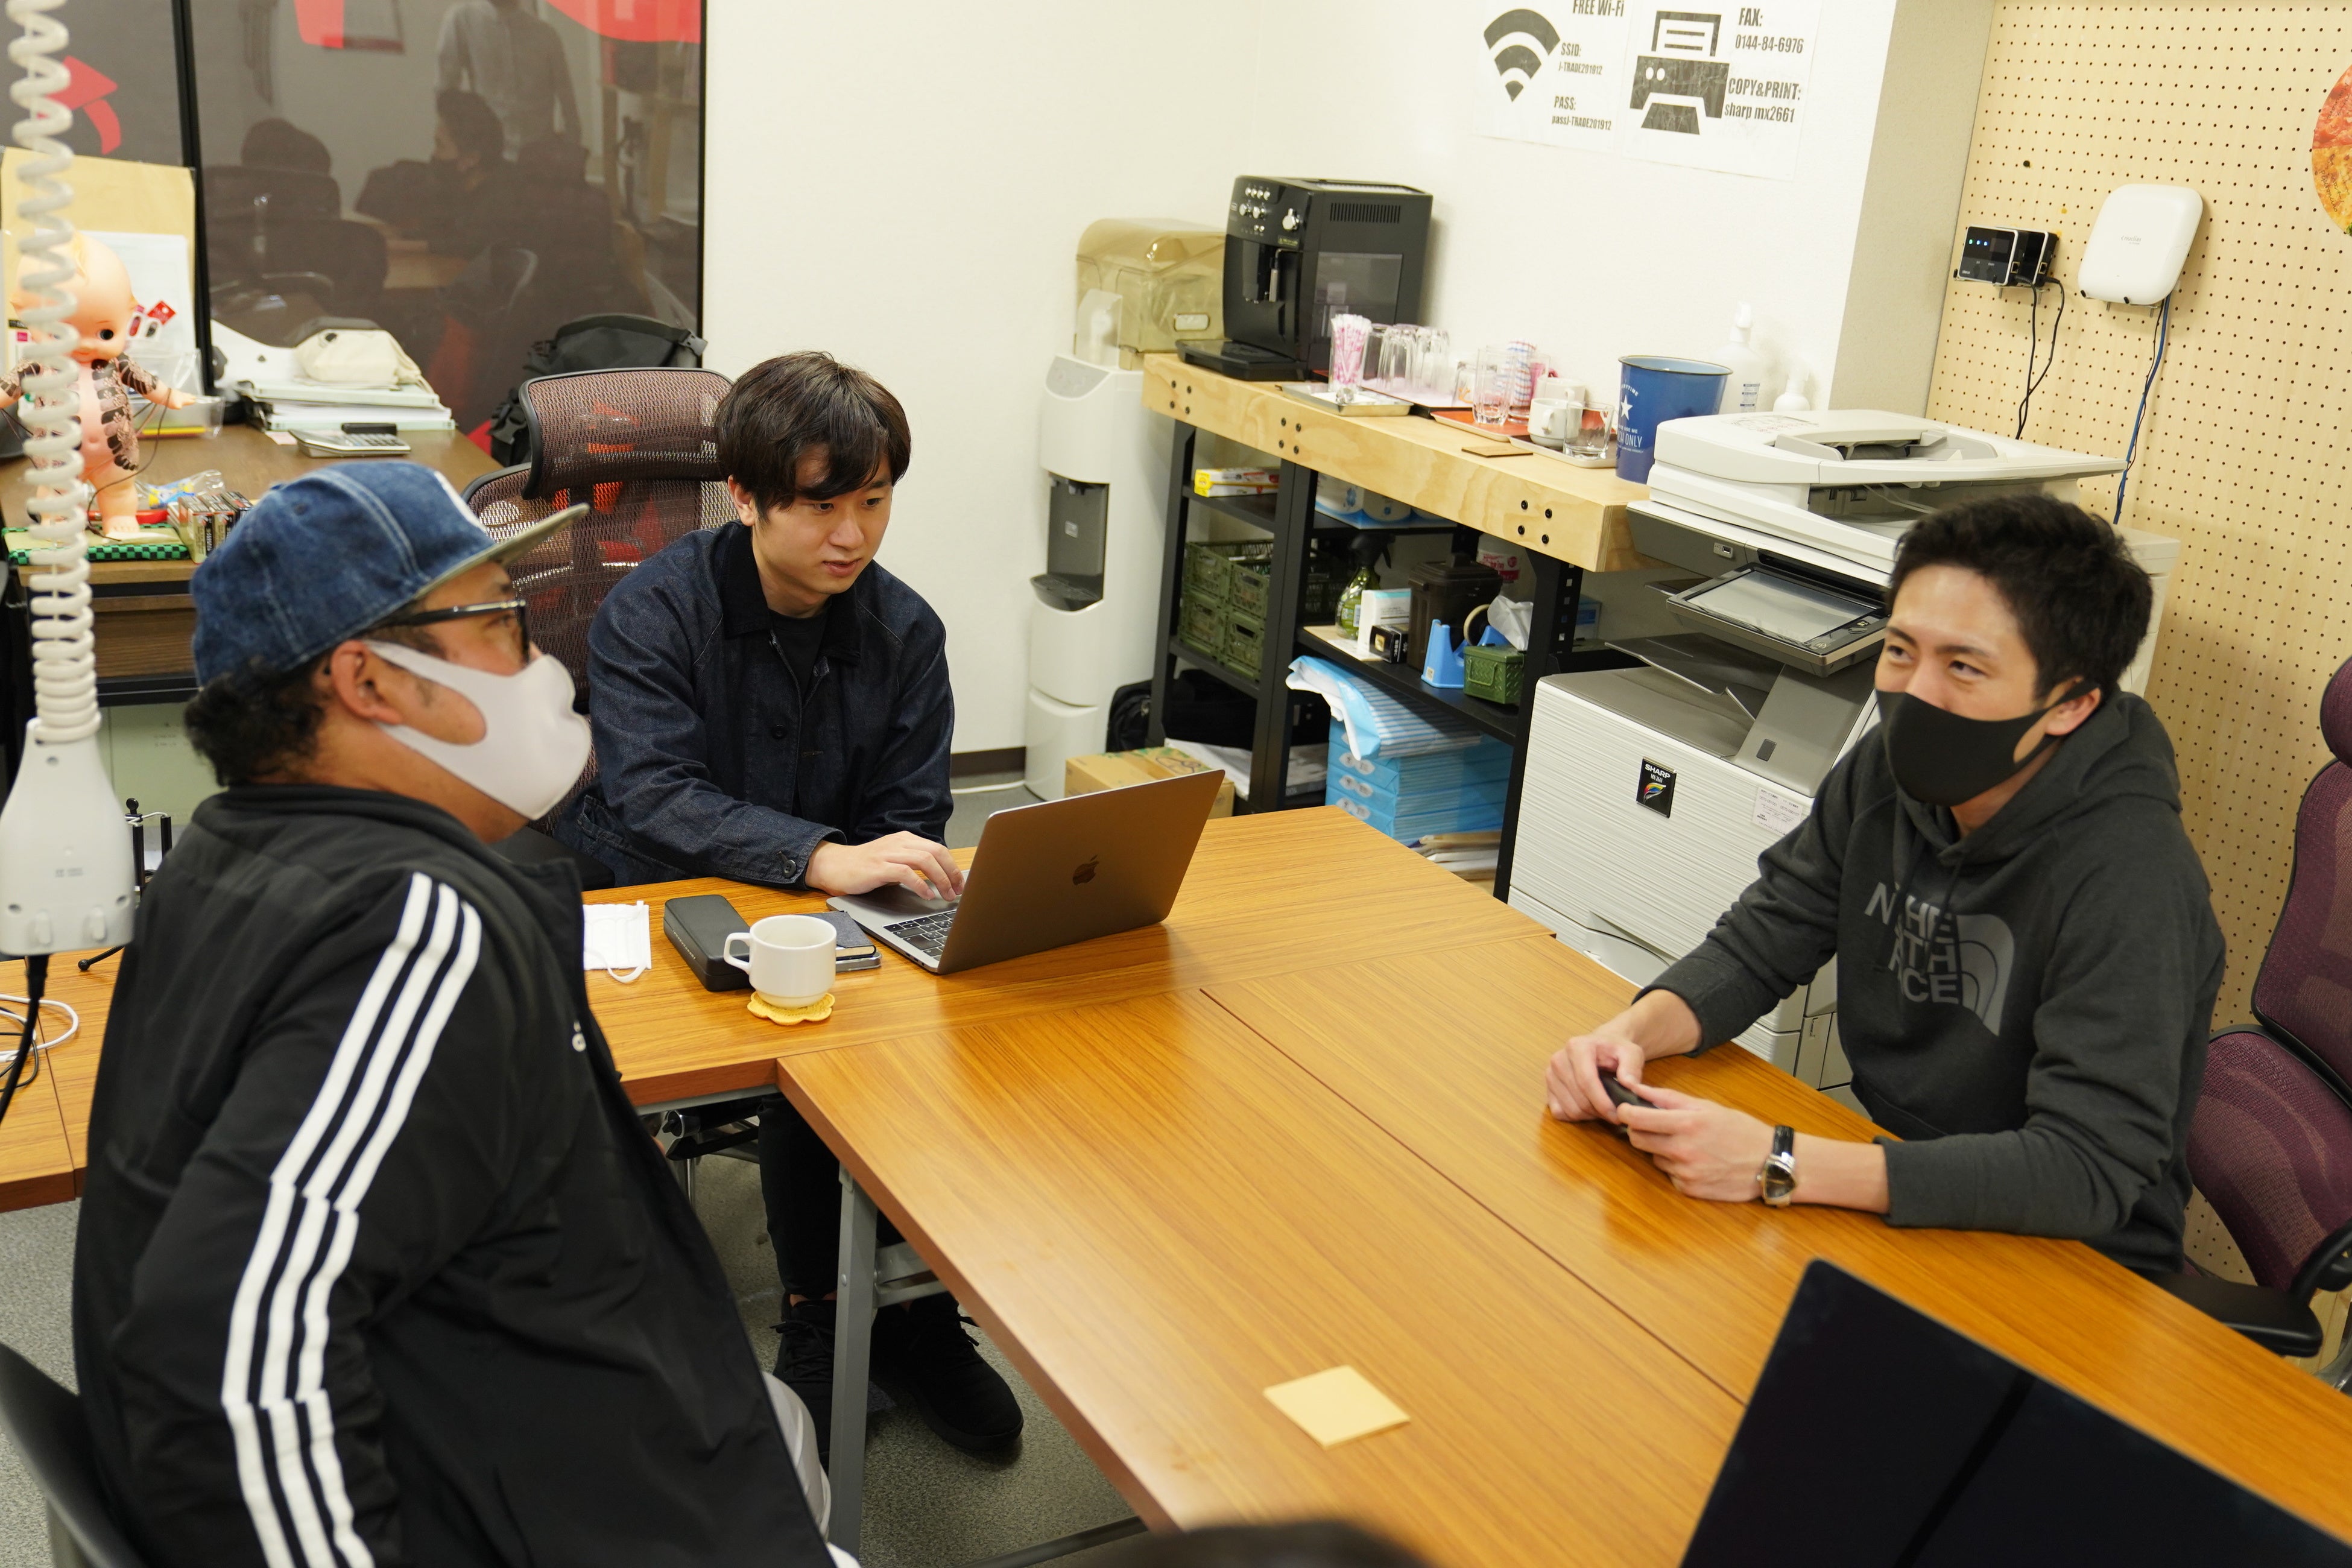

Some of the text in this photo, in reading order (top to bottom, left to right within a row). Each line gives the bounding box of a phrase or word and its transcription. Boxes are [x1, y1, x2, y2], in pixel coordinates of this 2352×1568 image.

[1573, 0, 1625, 17] FREE Wi-Fi
[1739, 7, 1763, 27] FAX:
[1561, 42, 1581, 57] SSID:
[1735, 34, 1804, 54] 0144-84-6976
[1728, 77, 1801, 100] COPY&PRINT:
[1554, 96, 1576, 110] PASS:
[1724, 102, 1795, 122] sharp mx2661
[1625, 434, 1643, 448] ONLY
[1645, 763, 1671, 779] SHARP
